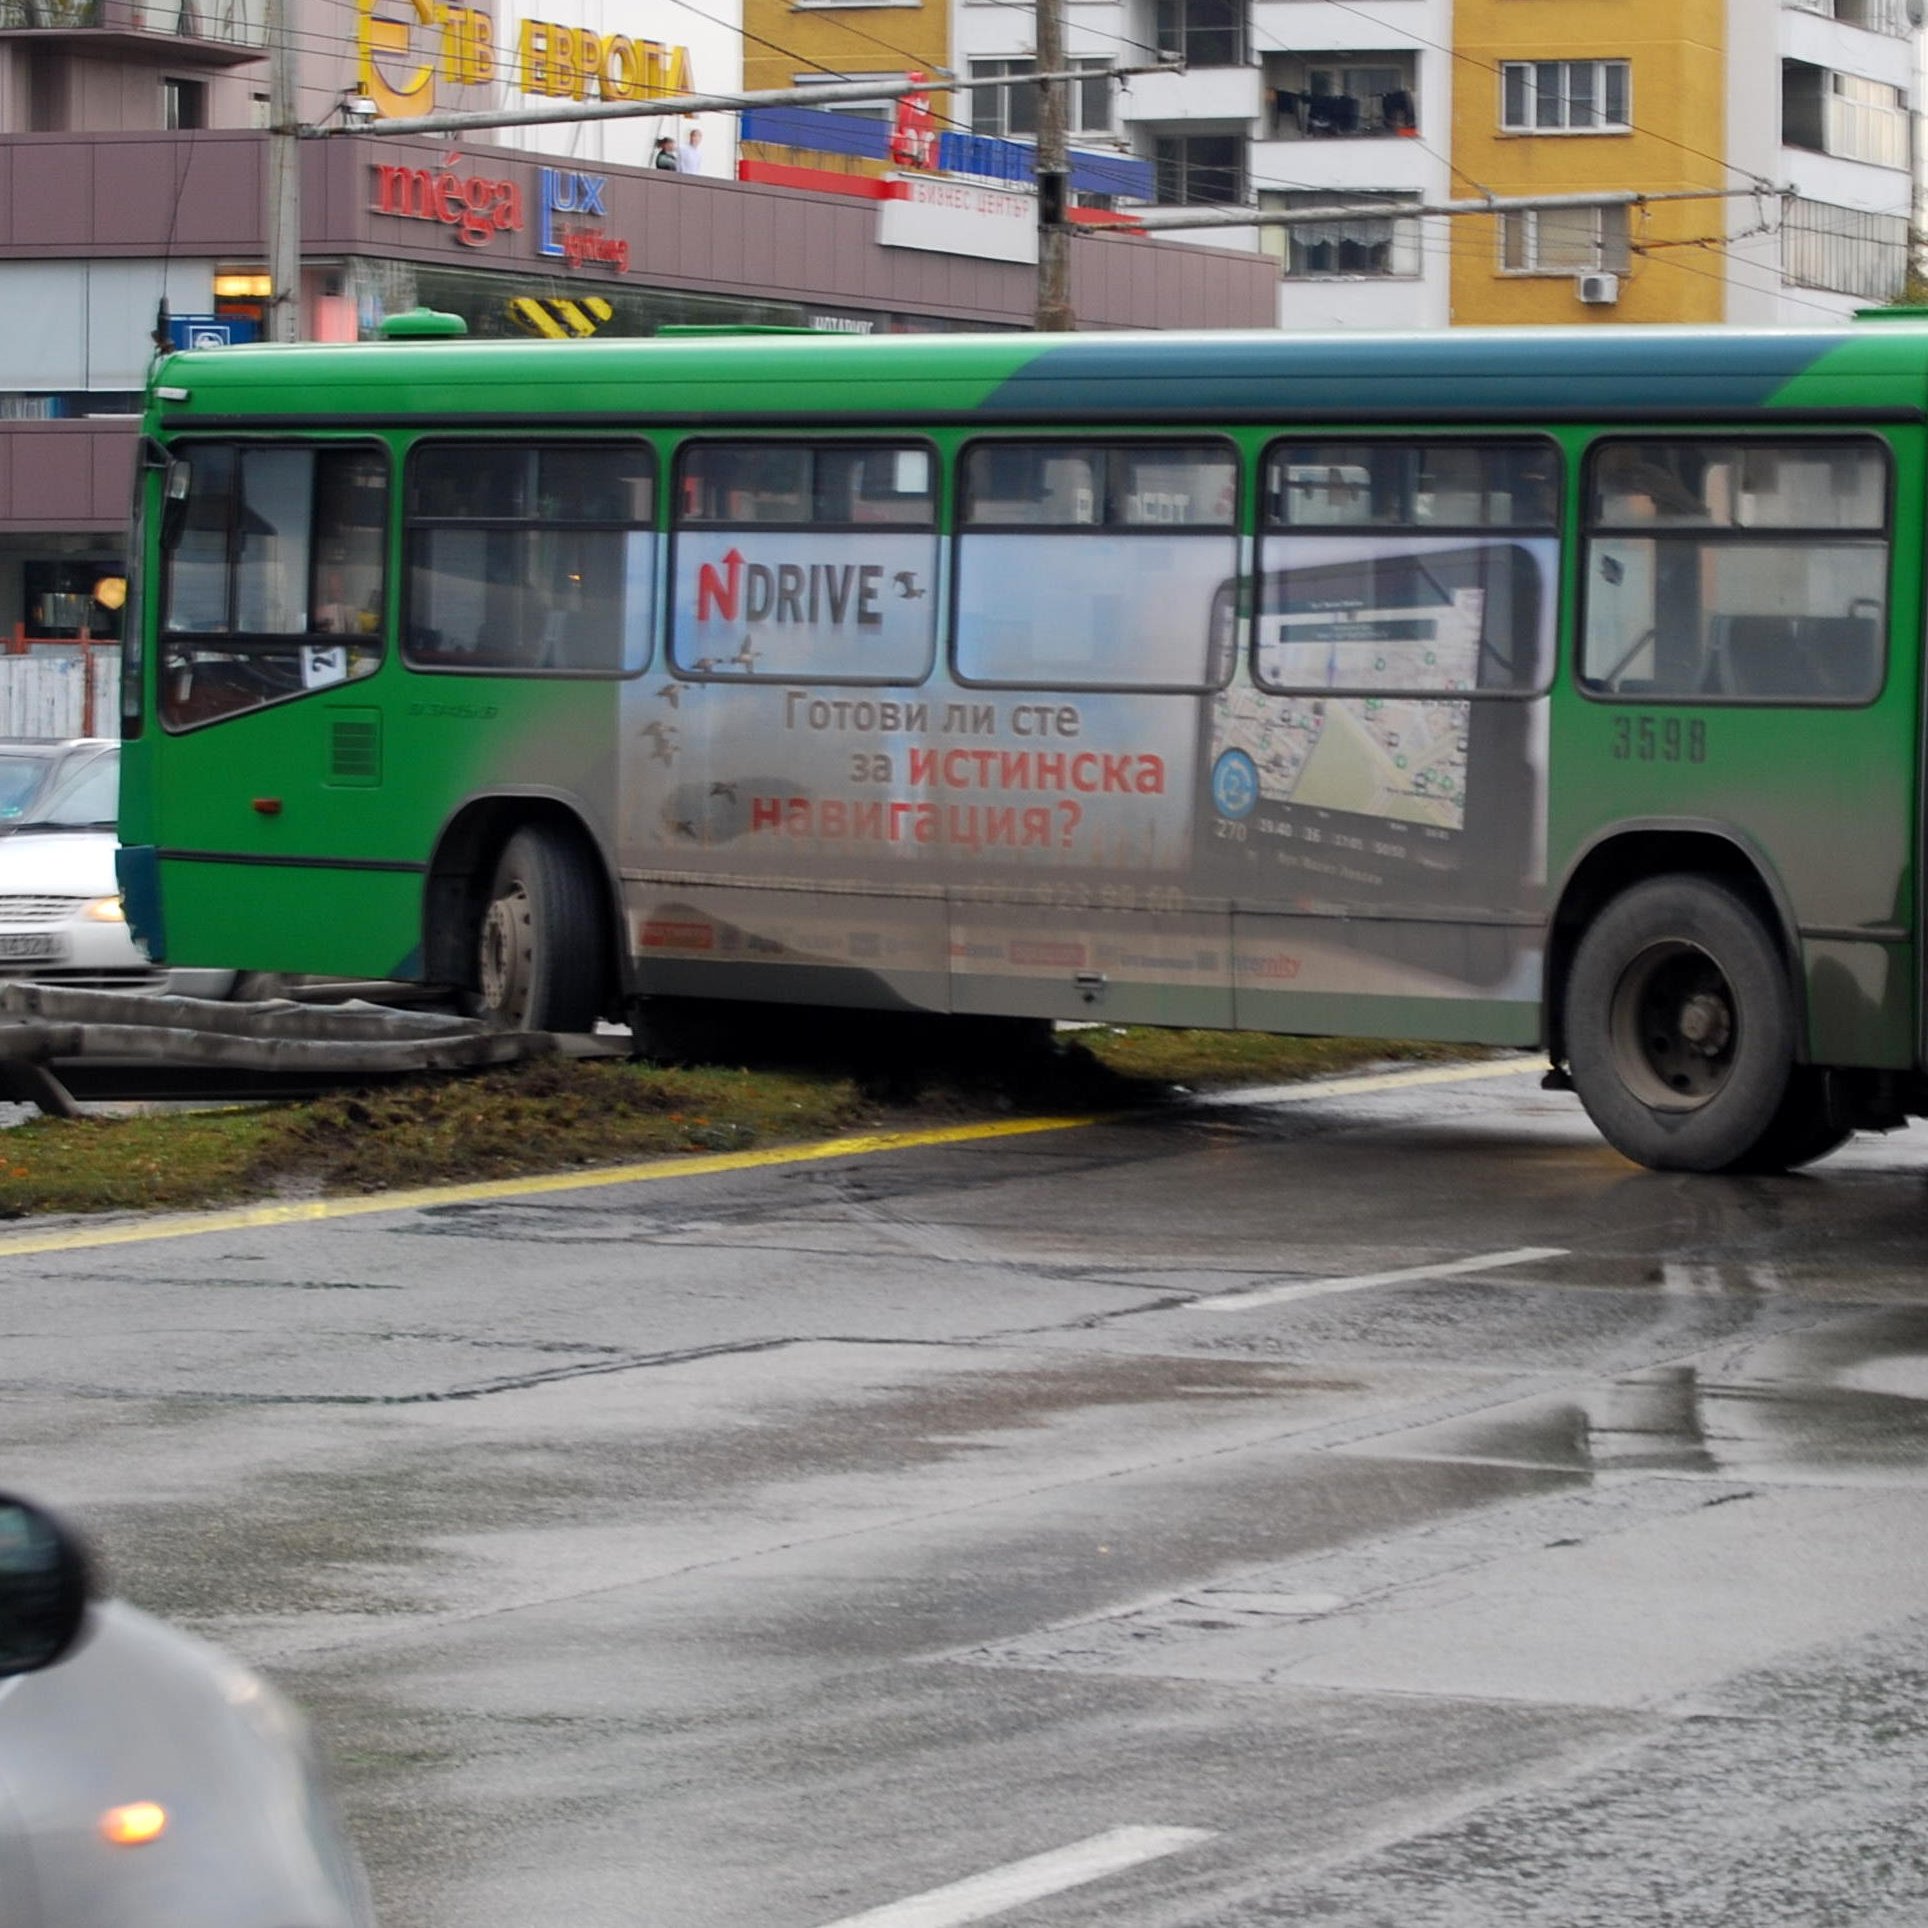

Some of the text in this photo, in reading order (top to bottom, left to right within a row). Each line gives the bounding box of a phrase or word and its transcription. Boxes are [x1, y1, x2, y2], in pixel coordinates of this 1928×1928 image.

[441, 6, 698, 106] ТВ ЕВРОПА
[372, 152, 524, 247] méga
[917, 183, 1030, 218] БИЗНЕС ЦЕНТЪР
[784, 691, 1081, 738] Готови ли сте
[1612, 715, 1707, 764] 3598
[849, 752, 894, 784] за
[751, 796, 1083, 851] навигация?
